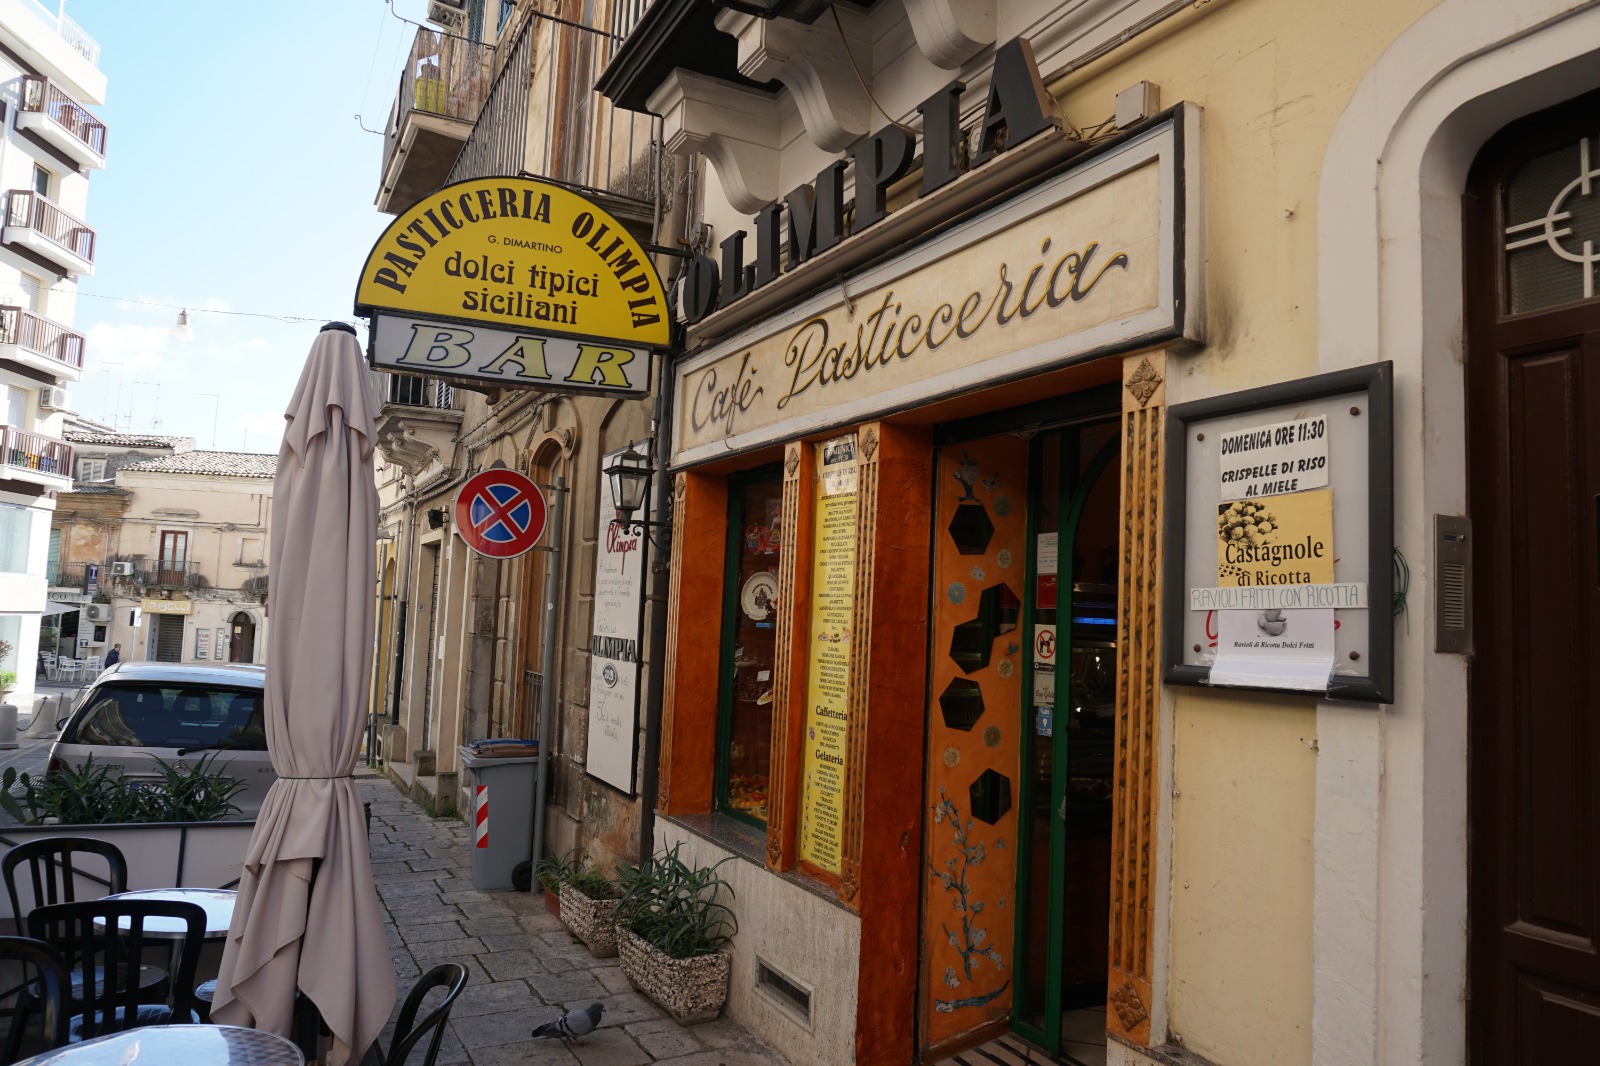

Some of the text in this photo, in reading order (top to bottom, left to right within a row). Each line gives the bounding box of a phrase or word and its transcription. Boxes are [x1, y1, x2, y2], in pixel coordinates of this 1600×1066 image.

[682, 36, 1061, 323] OLIMPIA
[373, 187, 661, 329] PASTICCERIA OLIMPIA
[487, 235, 563, 254] G. DIMARTINO
[444, 250, 599, 298] dolci tipici
[462, 287, 578, 325] siciliani
[777, 235, 1129, 410] Pasticceria
[396, 323, 635, 388] BAR
[1221, 419, 1325, 456] DOMENICA ORE 11:30
[1221, 455, 1326, 483] CRISPELLE DI RISO
[1245, 478, 1299, 497] AL MIELE
[1225, 535, 1324, 567] Castagnole
[1237, 569, 1311, 587] di Ricotta
[1191, 584, 1359, 609] RAVIOLI FRITTI CON RICOTTA
[592, 635, 638, 663] OLIMPIA
[1281, 641, 1297, 649] Dolci
[815, 749, 844, 766] Gelateria
